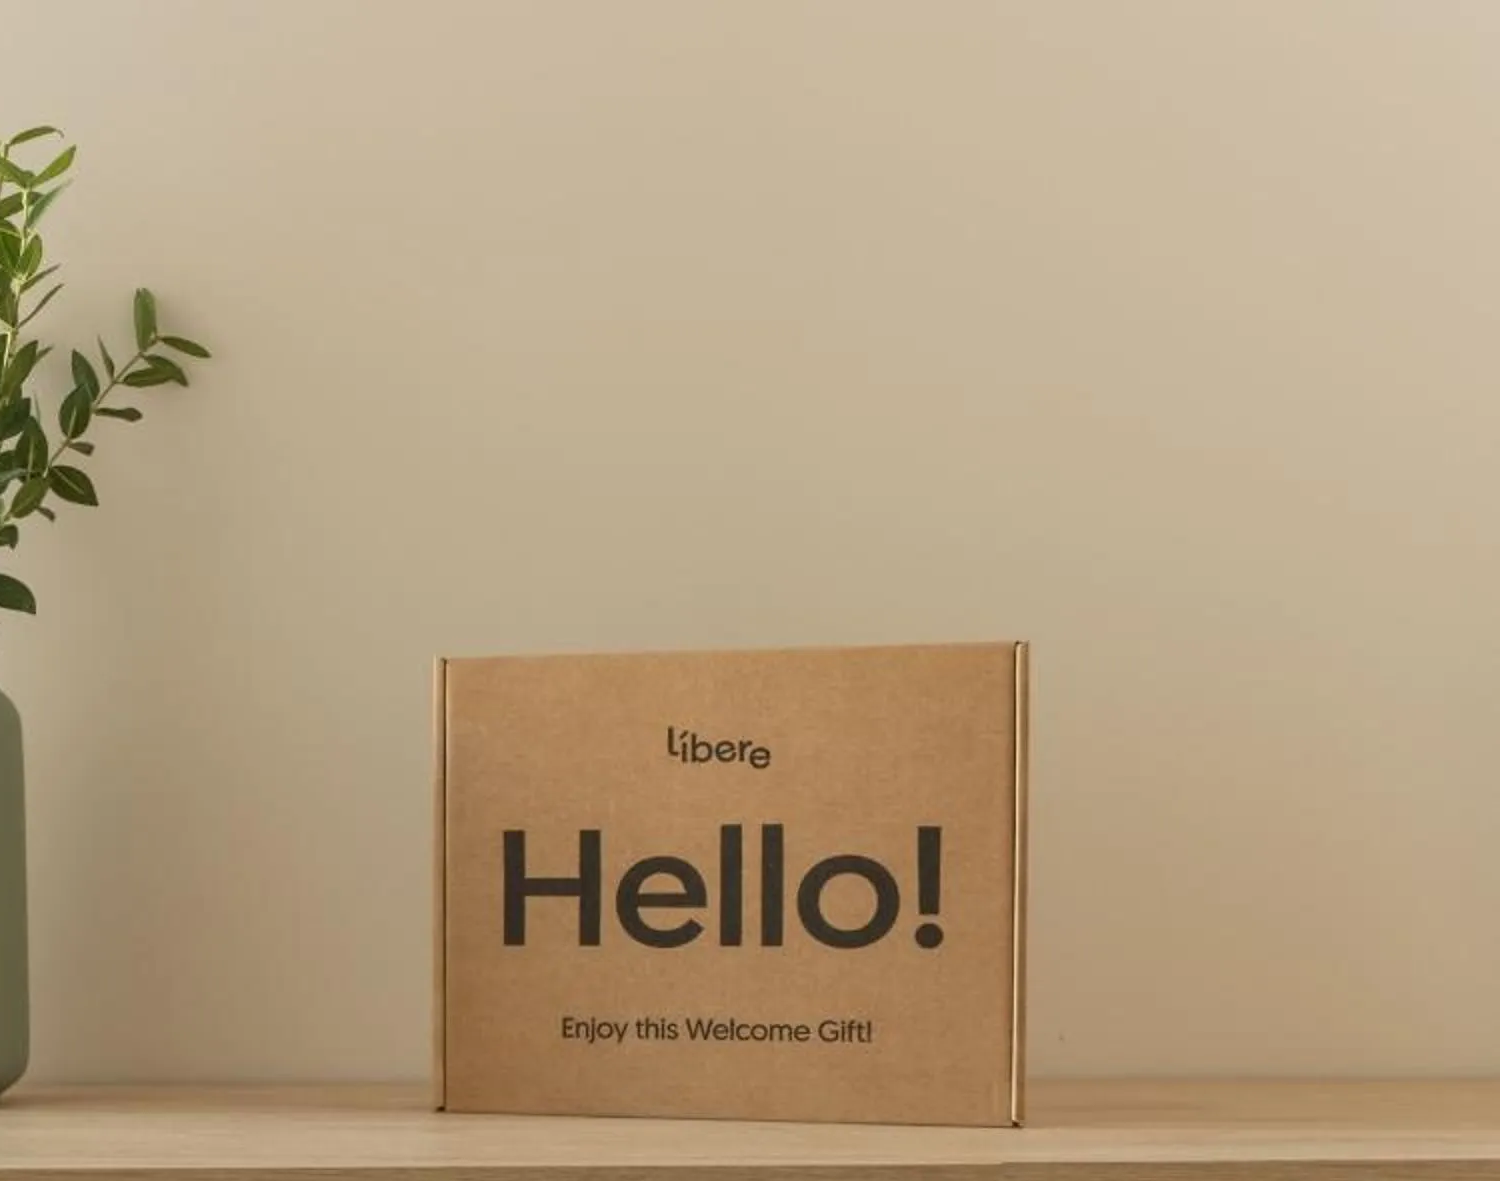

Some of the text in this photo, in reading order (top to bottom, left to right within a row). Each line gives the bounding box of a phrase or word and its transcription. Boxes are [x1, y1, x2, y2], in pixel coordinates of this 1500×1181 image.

[502, 823, 945, 950] Hello!
[561, 1016, 873, 1045] Enjoy this Welcome Gift!
